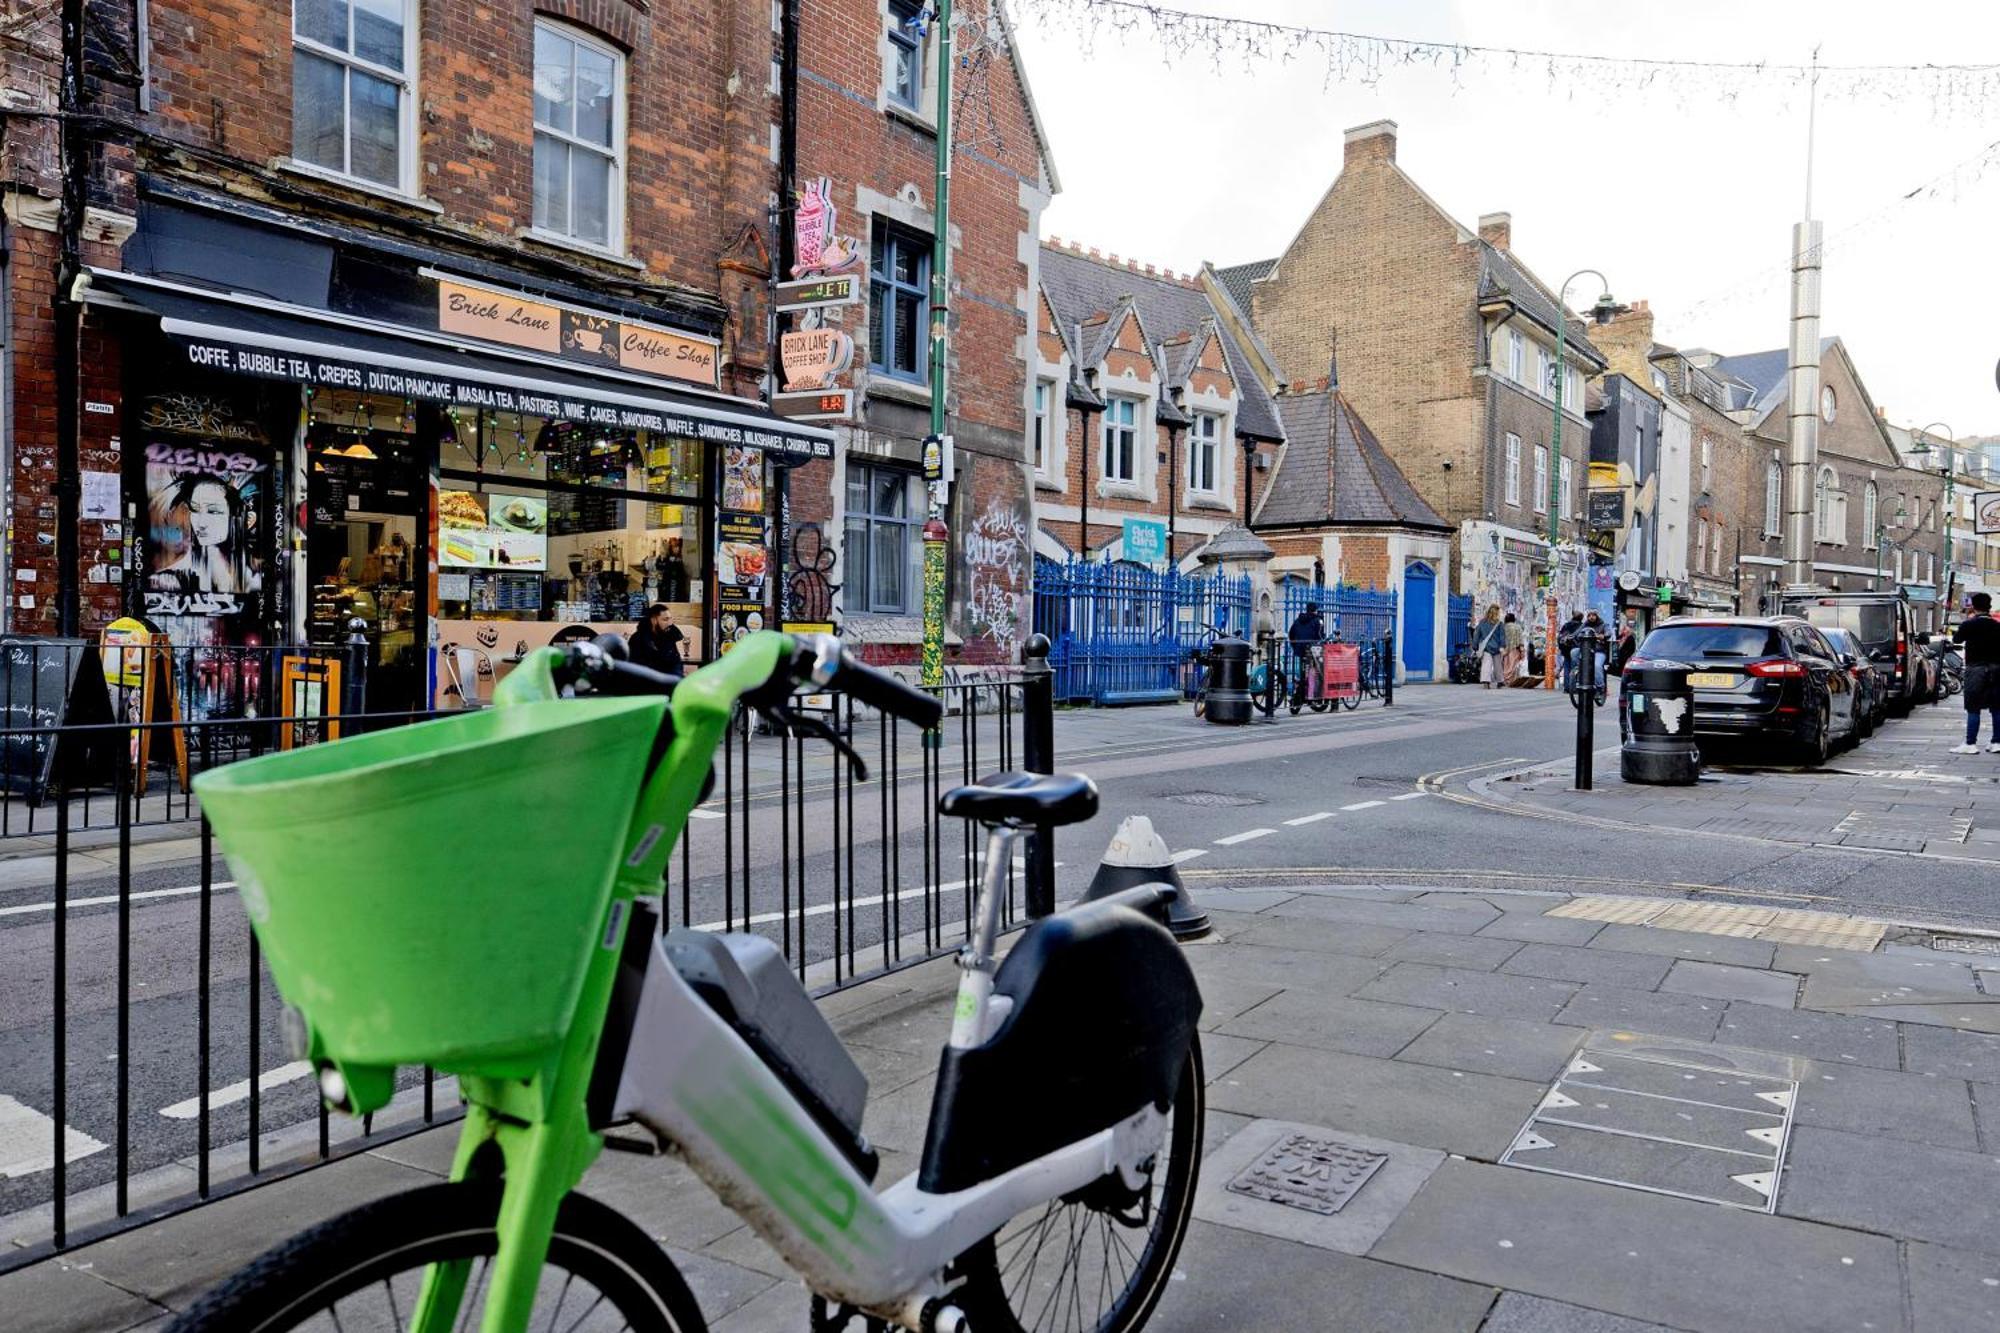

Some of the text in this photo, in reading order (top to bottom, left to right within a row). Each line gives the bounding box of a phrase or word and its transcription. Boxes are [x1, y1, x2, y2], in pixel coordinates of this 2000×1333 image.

[798, 219, 822, 233] BUBBLE
[804, 231, 817, 240] TEA
[448, 292, 711, 368] Brick Lane Coffee Shop
[784, 334, 829, 354] BRICK LANE
[784, 353, 827, 369] COFFEE SHOP
[238, 351, 287, 376] BUBBLE
[369, 372, 405, 393] DUTCH
[456, 385, 495, 407] MASALA
[814, 442, 831, 456] BEER
